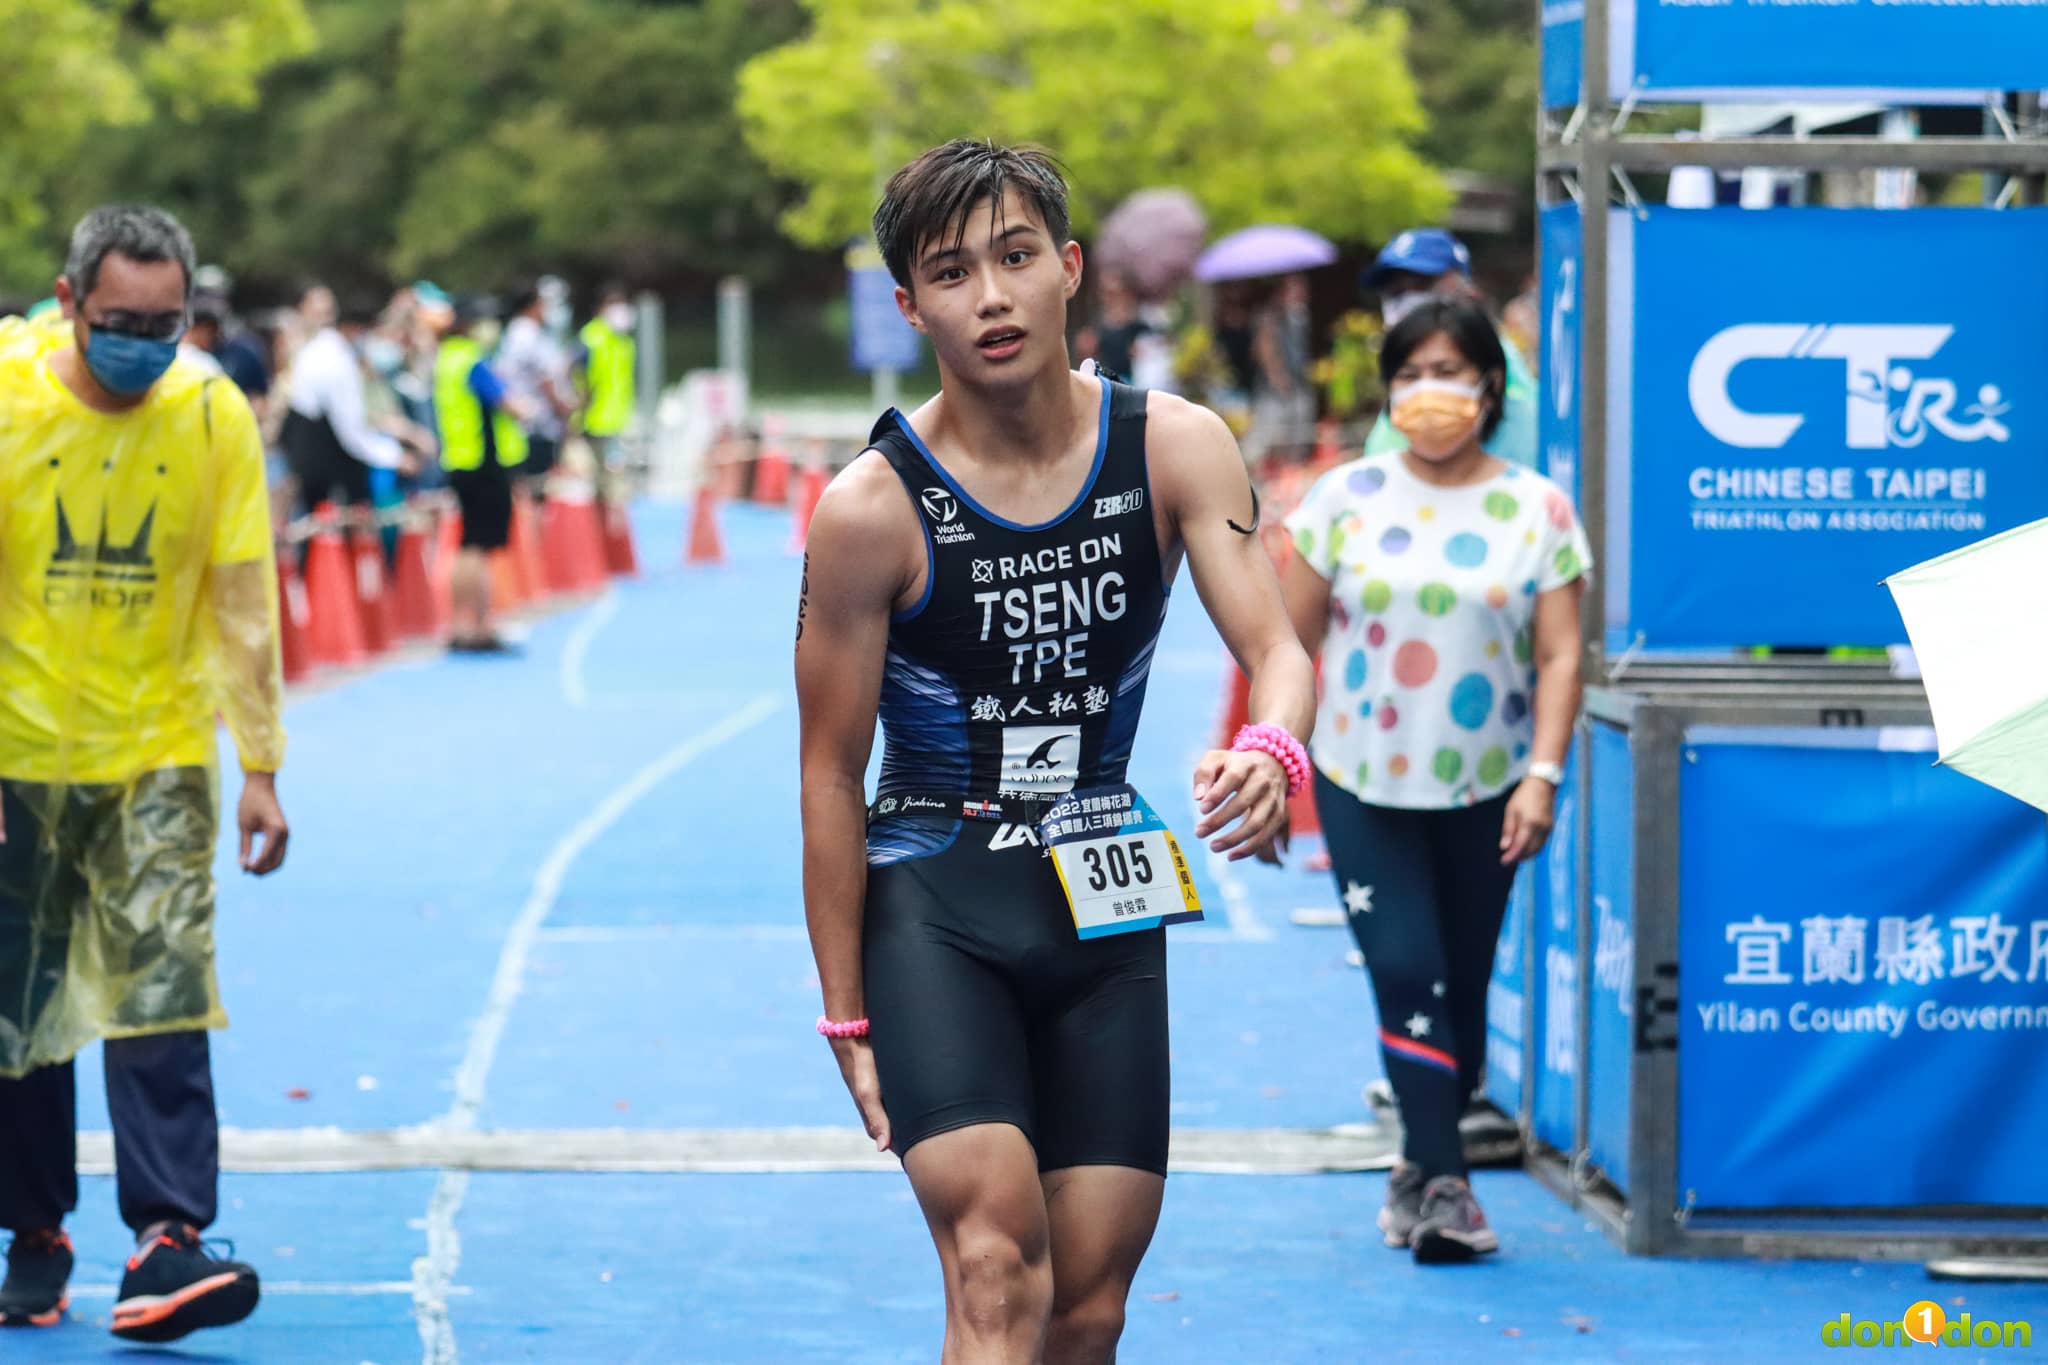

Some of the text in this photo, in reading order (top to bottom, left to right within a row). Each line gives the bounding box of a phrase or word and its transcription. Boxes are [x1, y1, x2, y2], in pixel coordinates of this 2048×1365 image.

[1688, 467, 1986, 499] CHINESE TAIPEI
[934, 532, 975, 544] Triathlon
[936, 522, 965, 534] World
[1690, 511, 1985, 531] TRIATHLON ASSOCIATION
[999, 533, 1122, 580] RACE ON
[974, 571, 1127, 641] TSENG
[1008, 632, 1089, 685] TPE
[1083, 841, 1153, 891] 305
[1697, 1001, 1781, 1033] Yilan
[1788, 1001, 1908, 1039] County
